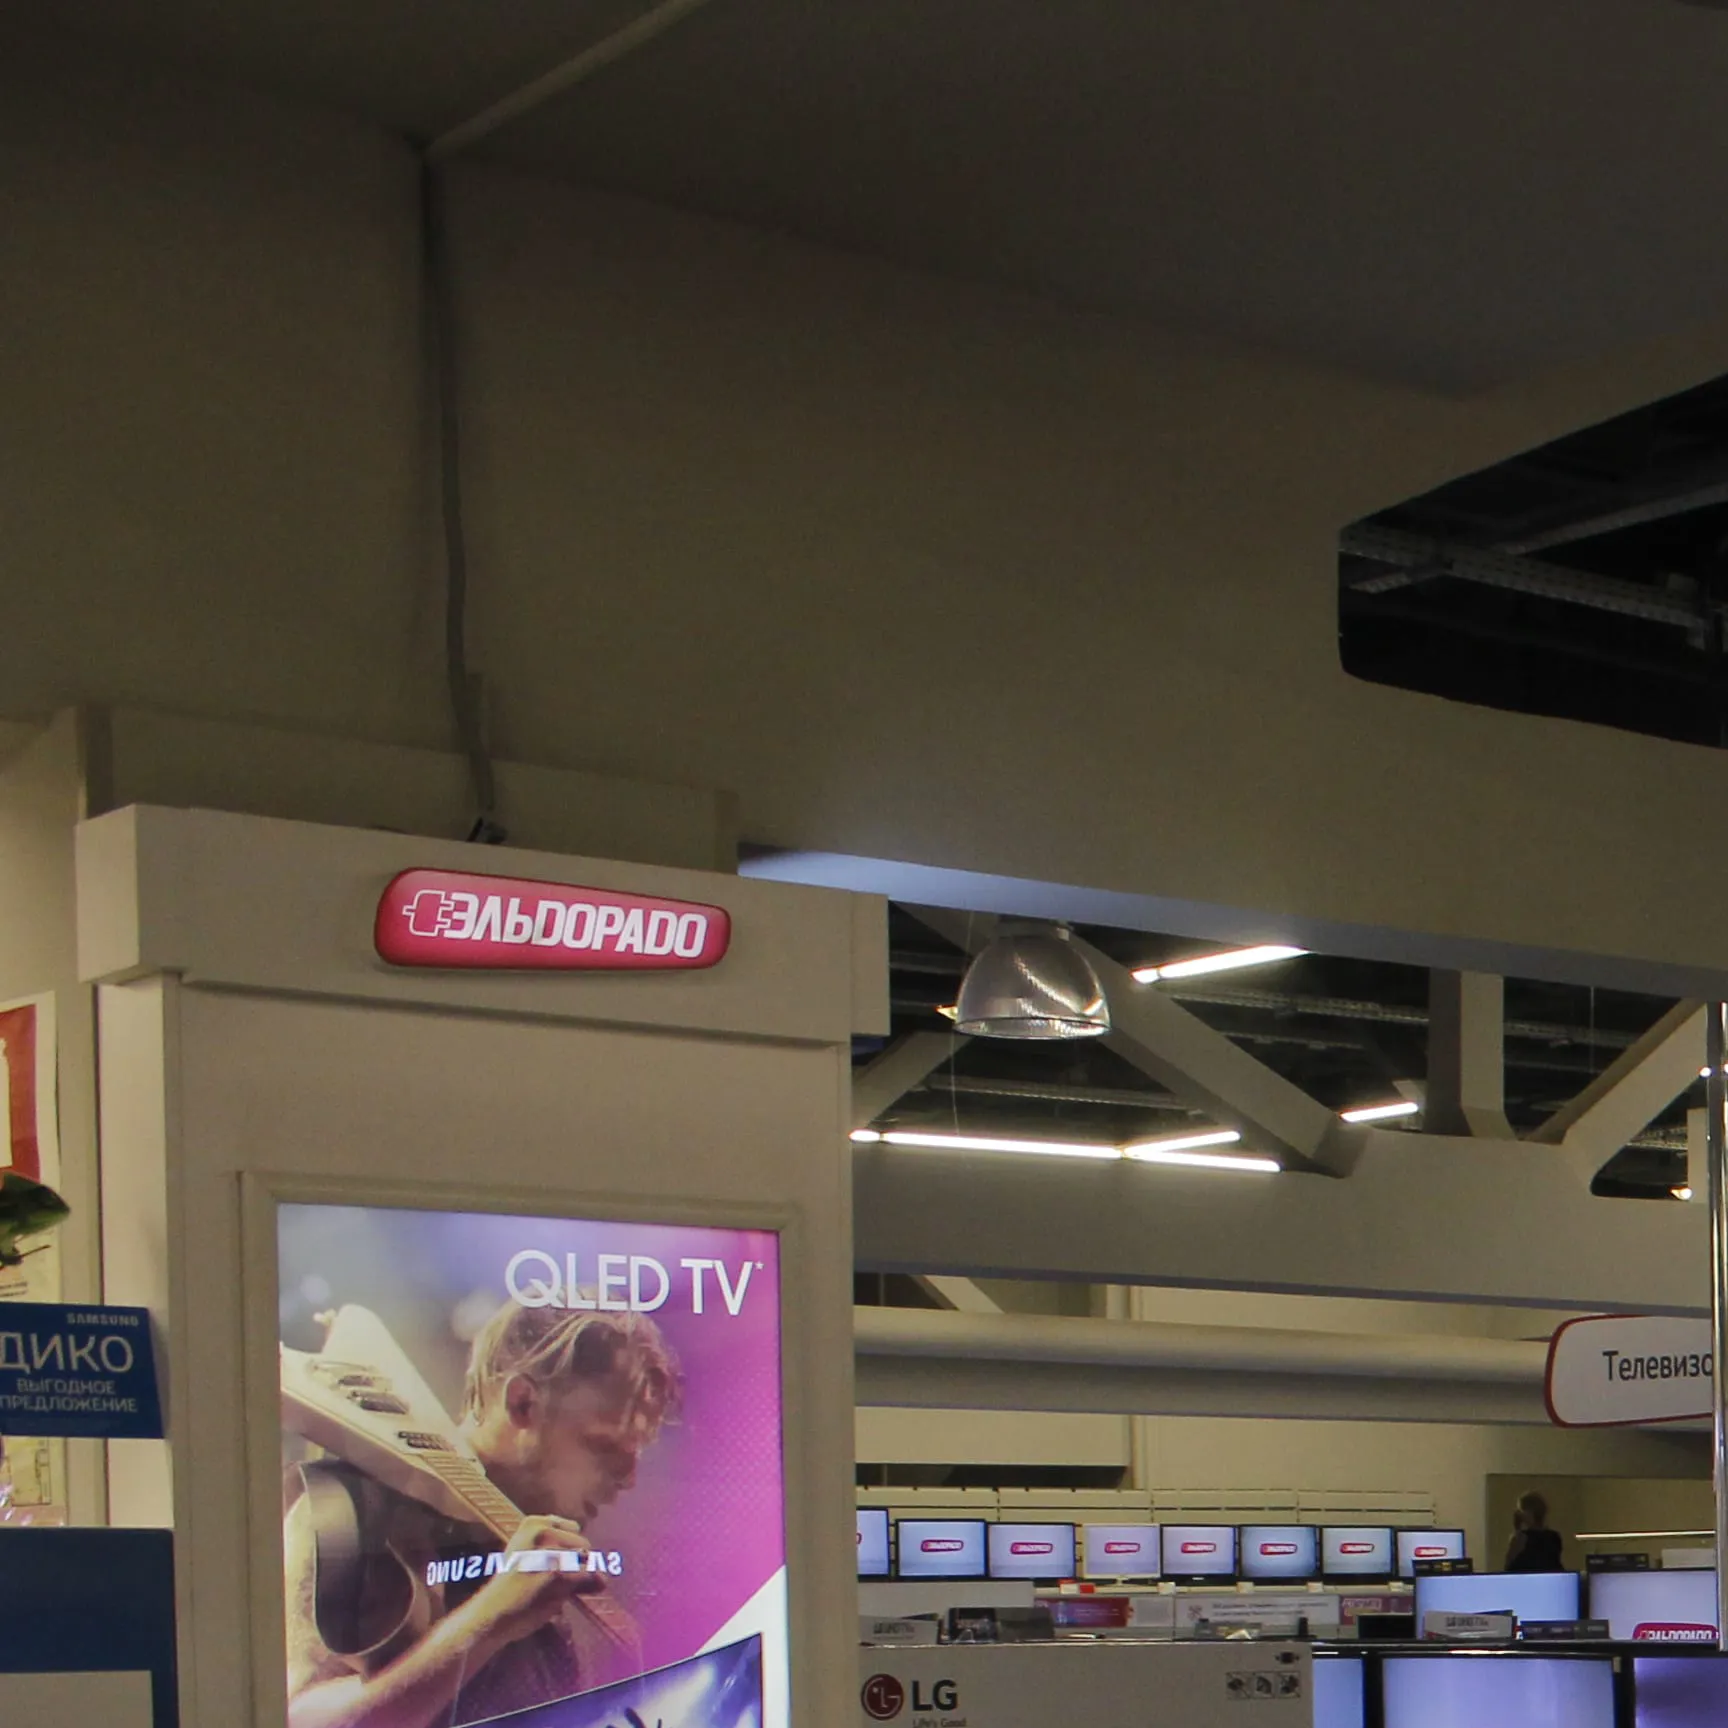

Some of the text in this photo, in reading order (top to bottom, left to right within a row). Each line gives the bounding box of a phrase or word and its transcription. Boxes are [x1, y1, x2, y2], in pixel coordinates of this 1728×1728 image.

[505, 1249, 669, 1312] QLED
[66, 1312, 140, 1327] SAMSUNG
[16, 1376, 117, 1395] ВЫГОДНОЕ
[0, 1394, 138, 1413] ПРЕДЛОЖЕНИЕ
[911, 1679, 959, 1712] LG
